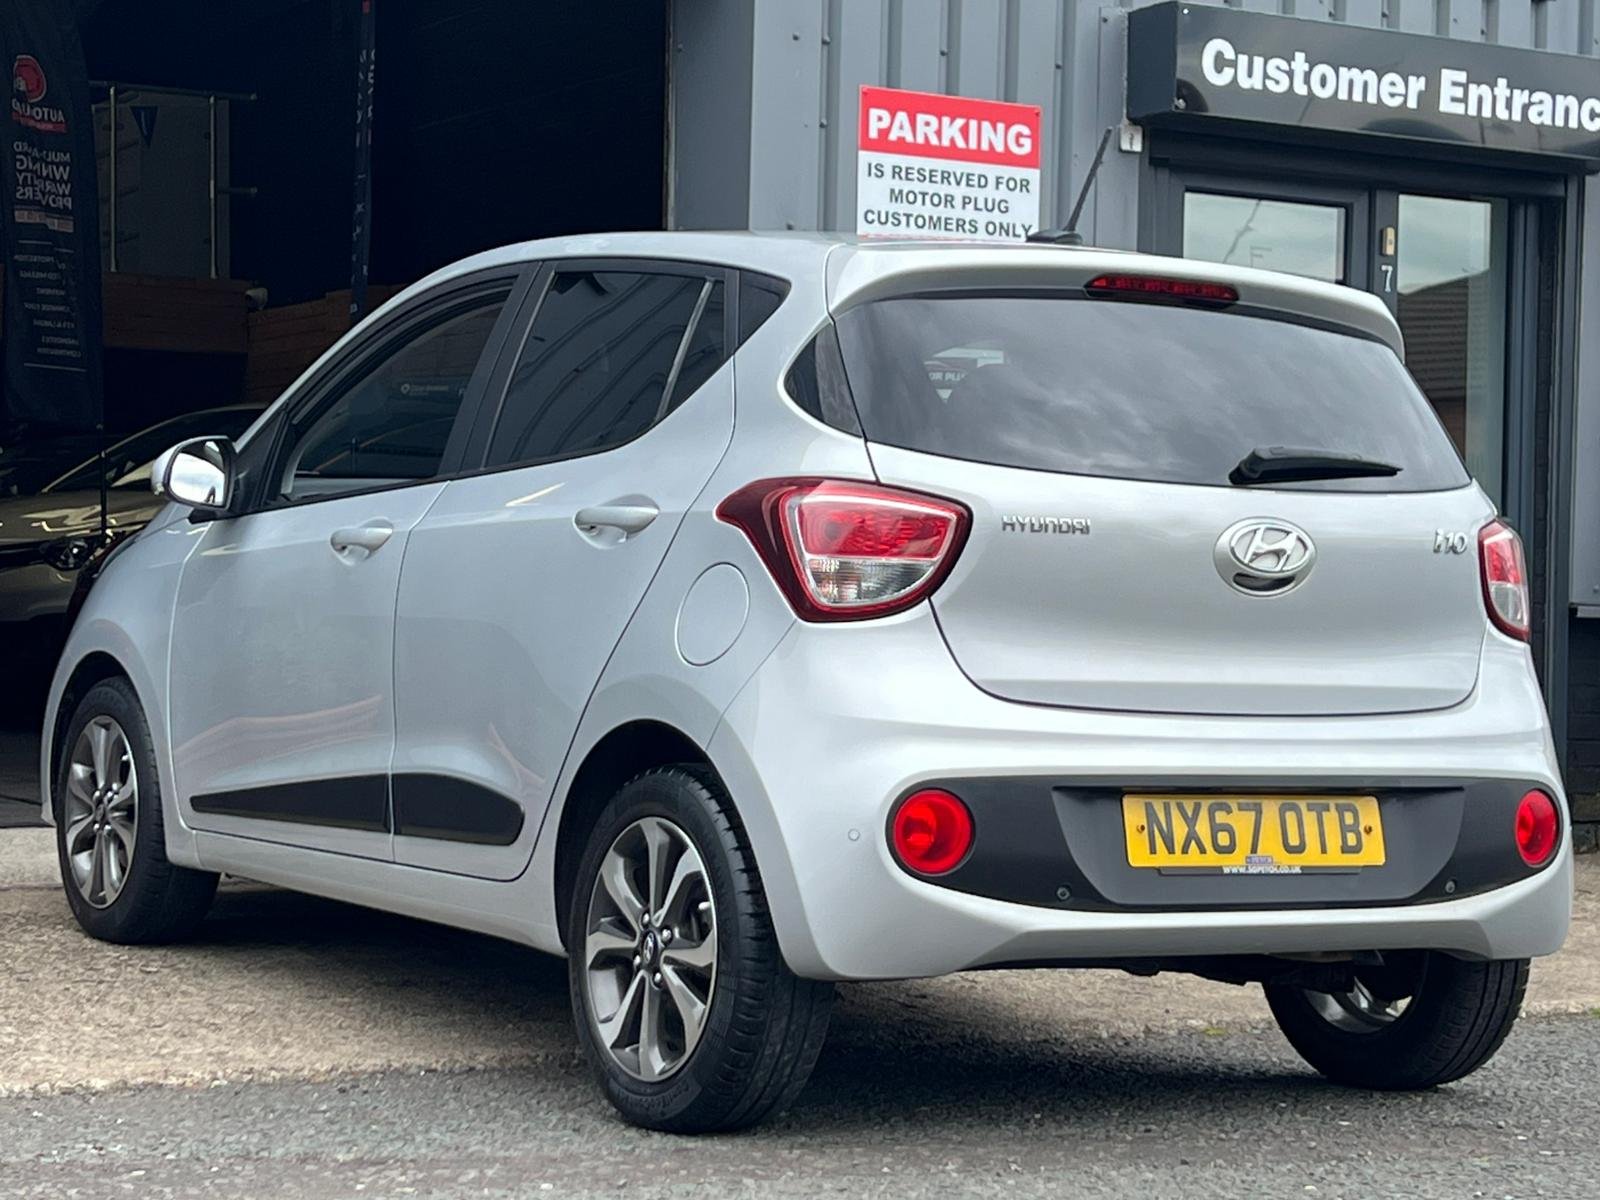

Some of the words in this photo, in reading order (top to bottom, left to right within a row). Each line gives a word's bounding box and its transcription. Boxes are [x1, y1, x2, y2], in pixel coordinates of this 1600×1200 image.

[1201, 37, 1427, 110] Customer
[868, 107, 1033, 156] PARKING
[867, 162, 885, 178] IS
[892, 165, 989, 189] RESERVED
[995, 175, 1031, 194] FOR
[889, 188, 955, 210] MOTOR
[962, 195, 1010, 214] PLUG
[864, 209, 979, 235] CUSTOMERS
[985, 220, 1033, 239] ONLY
[1381, 264, 1393, 292] 7
[1002, 515, 1091, 535] HYUNDAI
[1433, 528, 1468, 555] i10
[1145, 801, 1263, 855] NX67
[1278, 801, 1364, 855] OTB
